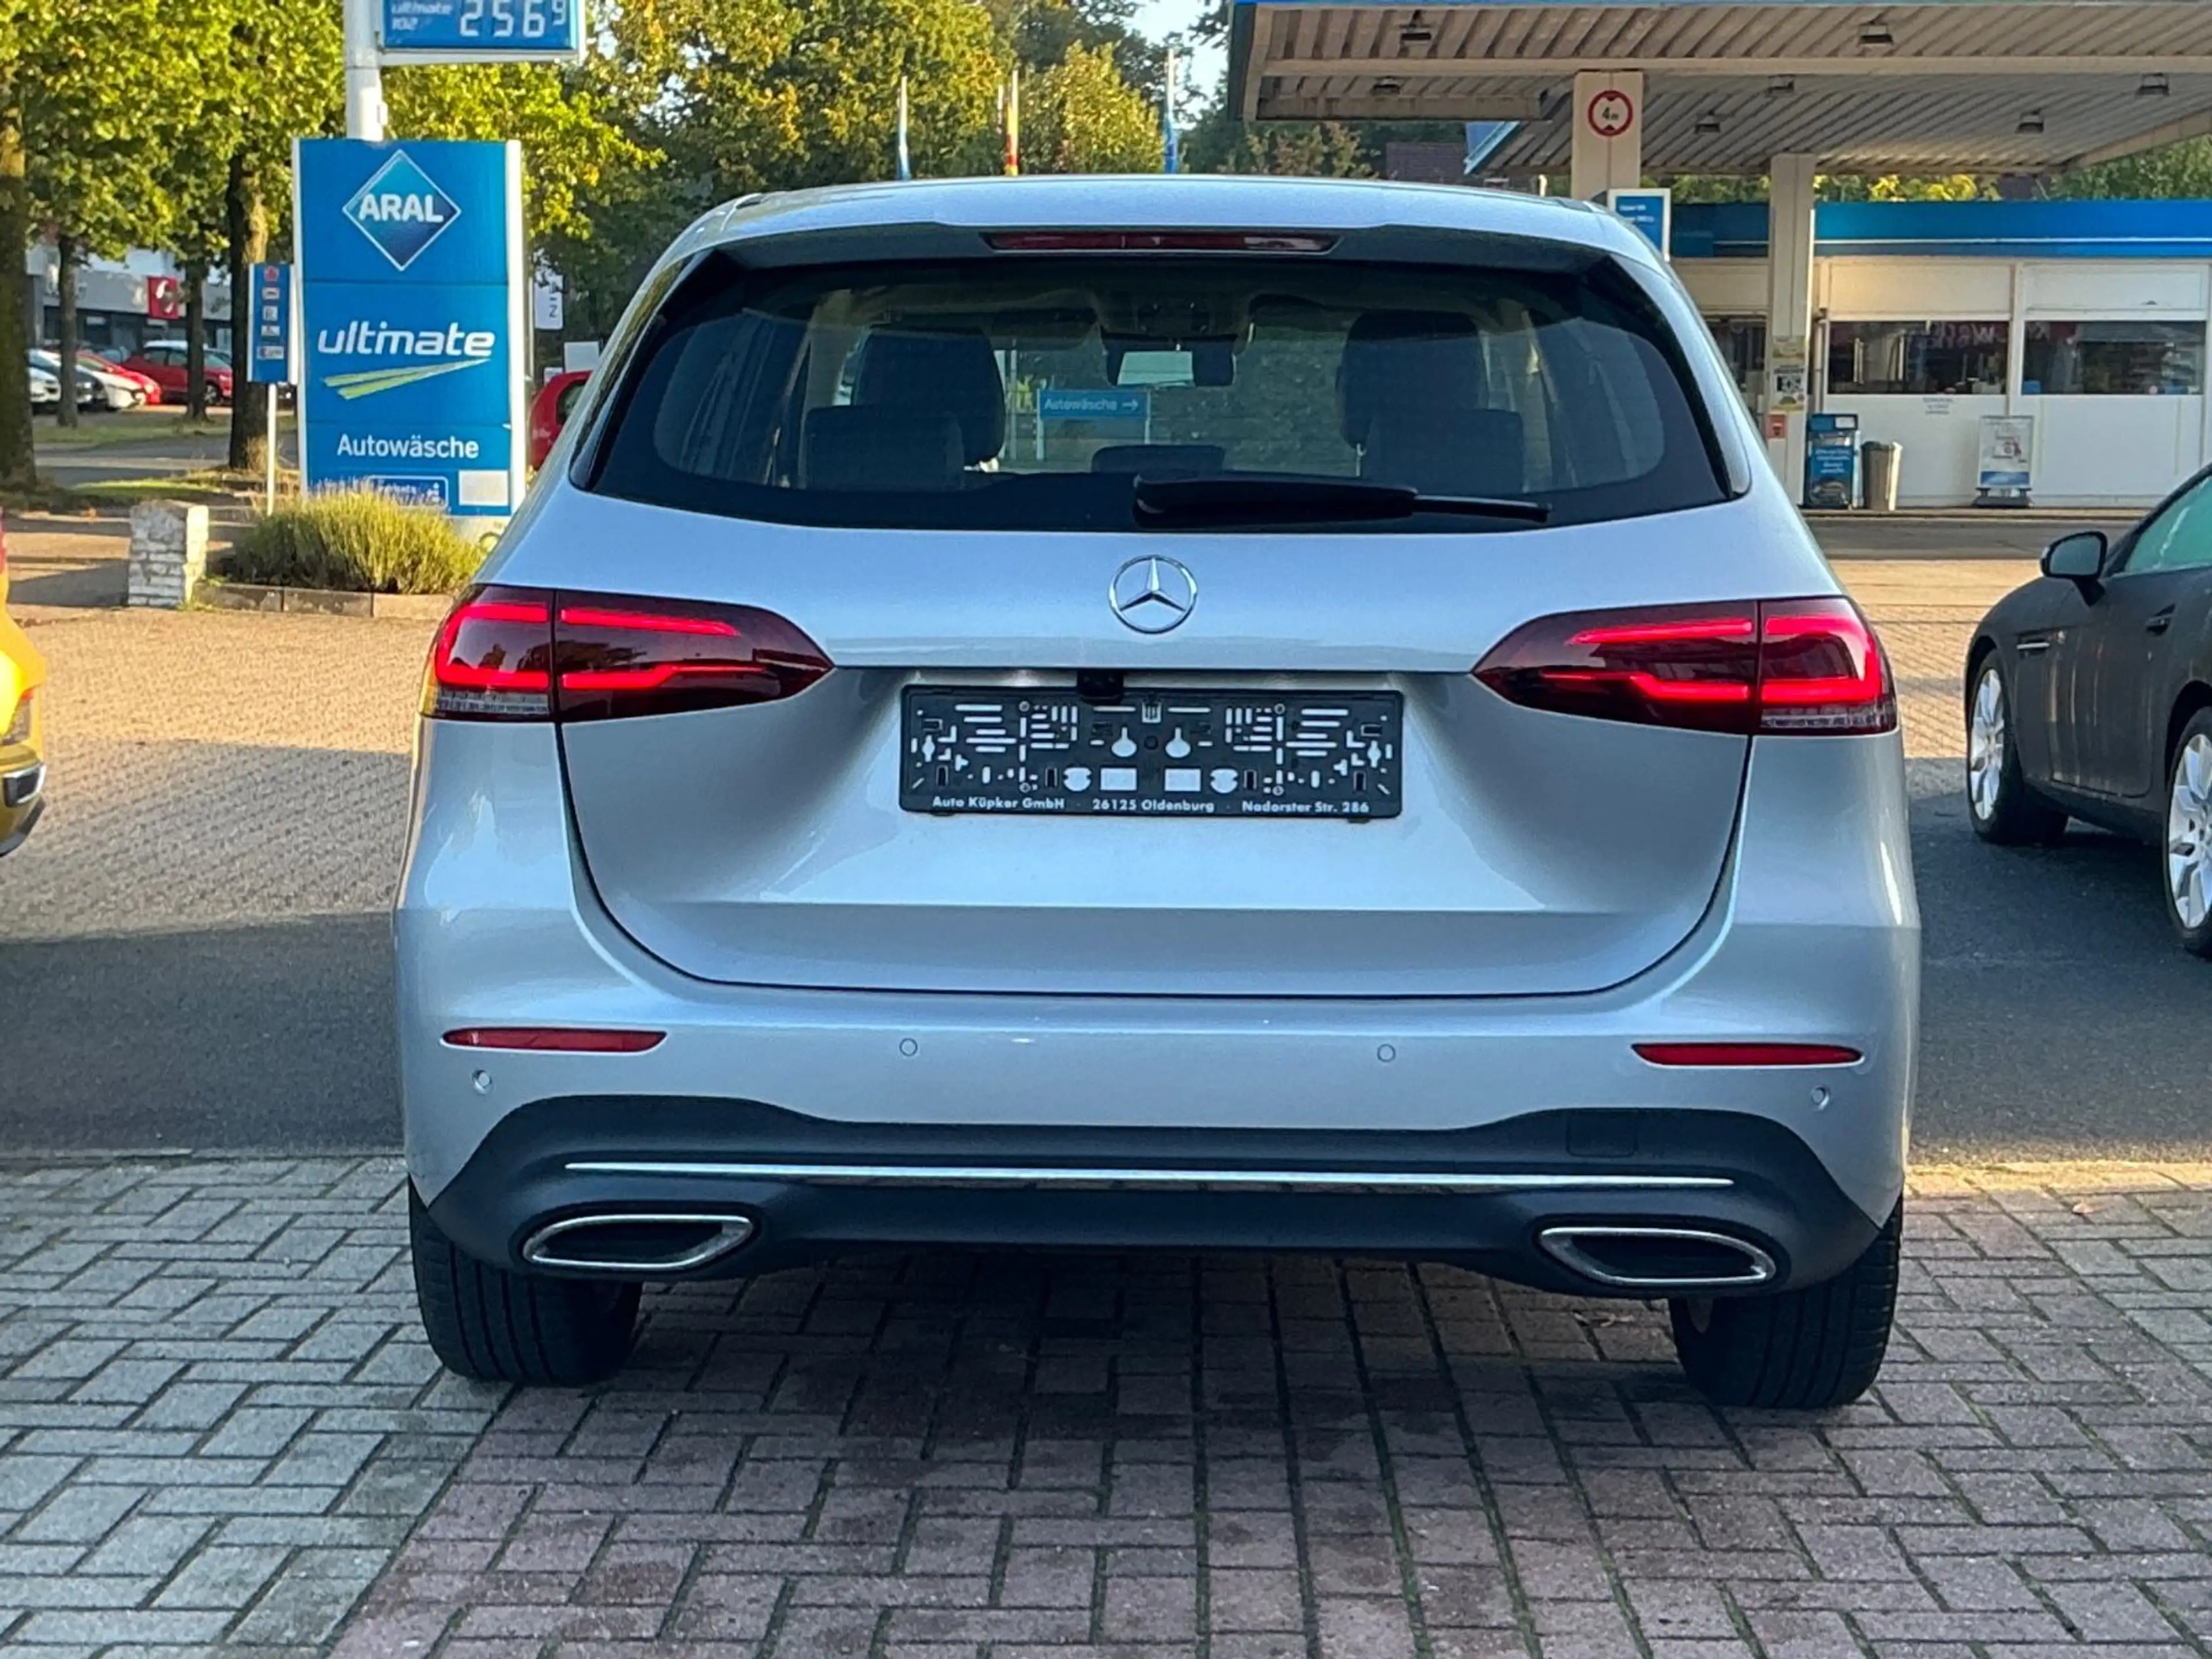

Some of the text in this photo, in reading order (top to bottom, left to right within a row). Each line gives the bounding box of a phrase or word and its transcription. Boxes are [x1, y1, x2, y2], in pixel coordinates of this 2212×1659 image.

[358, 193, 444, 223] ARAL
[317, 320, 495, 357] ultimate
[337, 433, 479, 459] Autowäsche
[933, 796, 1370, 813] Auto Küpker GmbH 26125 Oldenburg Nadorster Str. 286
